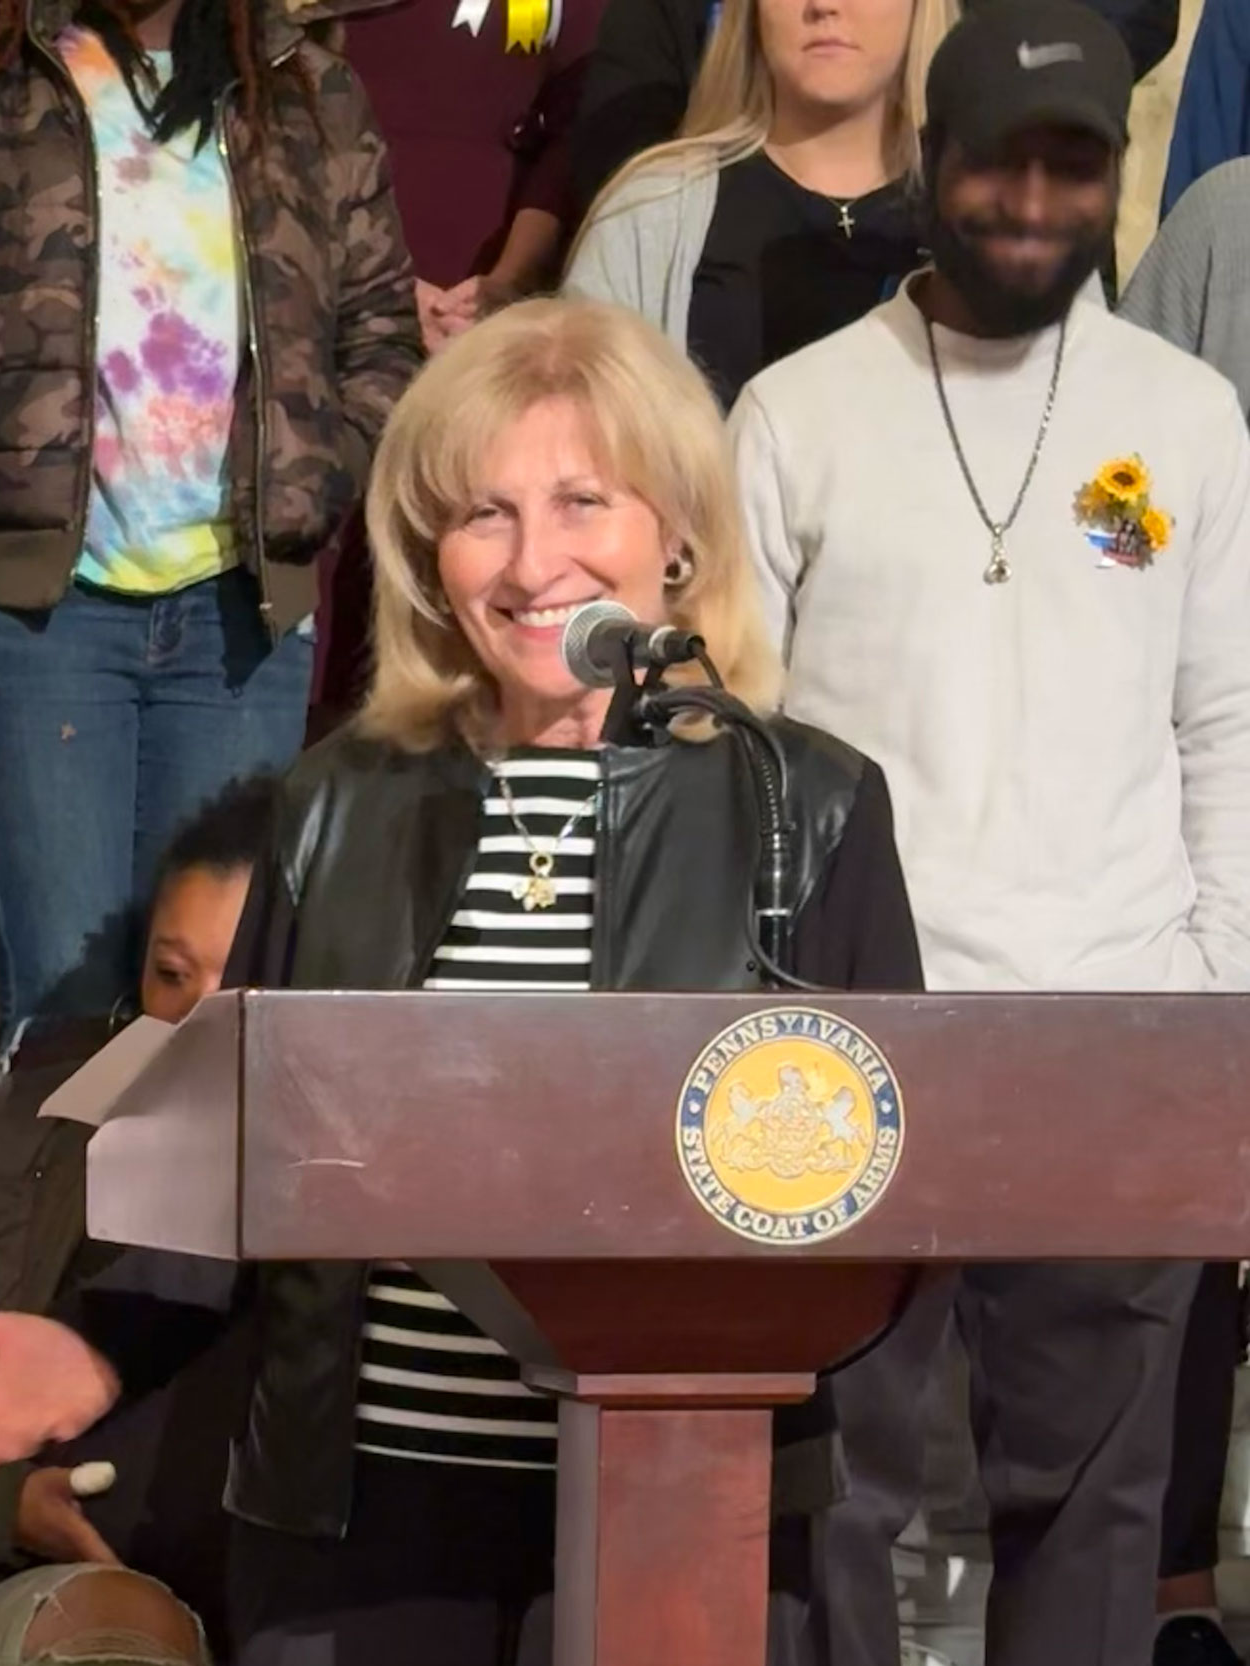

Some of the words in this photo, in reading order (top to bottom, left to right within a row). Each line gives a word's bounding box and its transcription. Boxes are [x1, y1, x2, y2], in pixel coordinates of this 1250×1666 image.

[691, 1013, 890, 1095] PENNSYLVANIA
[682, 1126, 736, 1217] STATE
[733, 1207, 808, 1239] COAT
[811, 1199, 852, 1235] OF
[851, 1127, 899, 1206] ARMS
